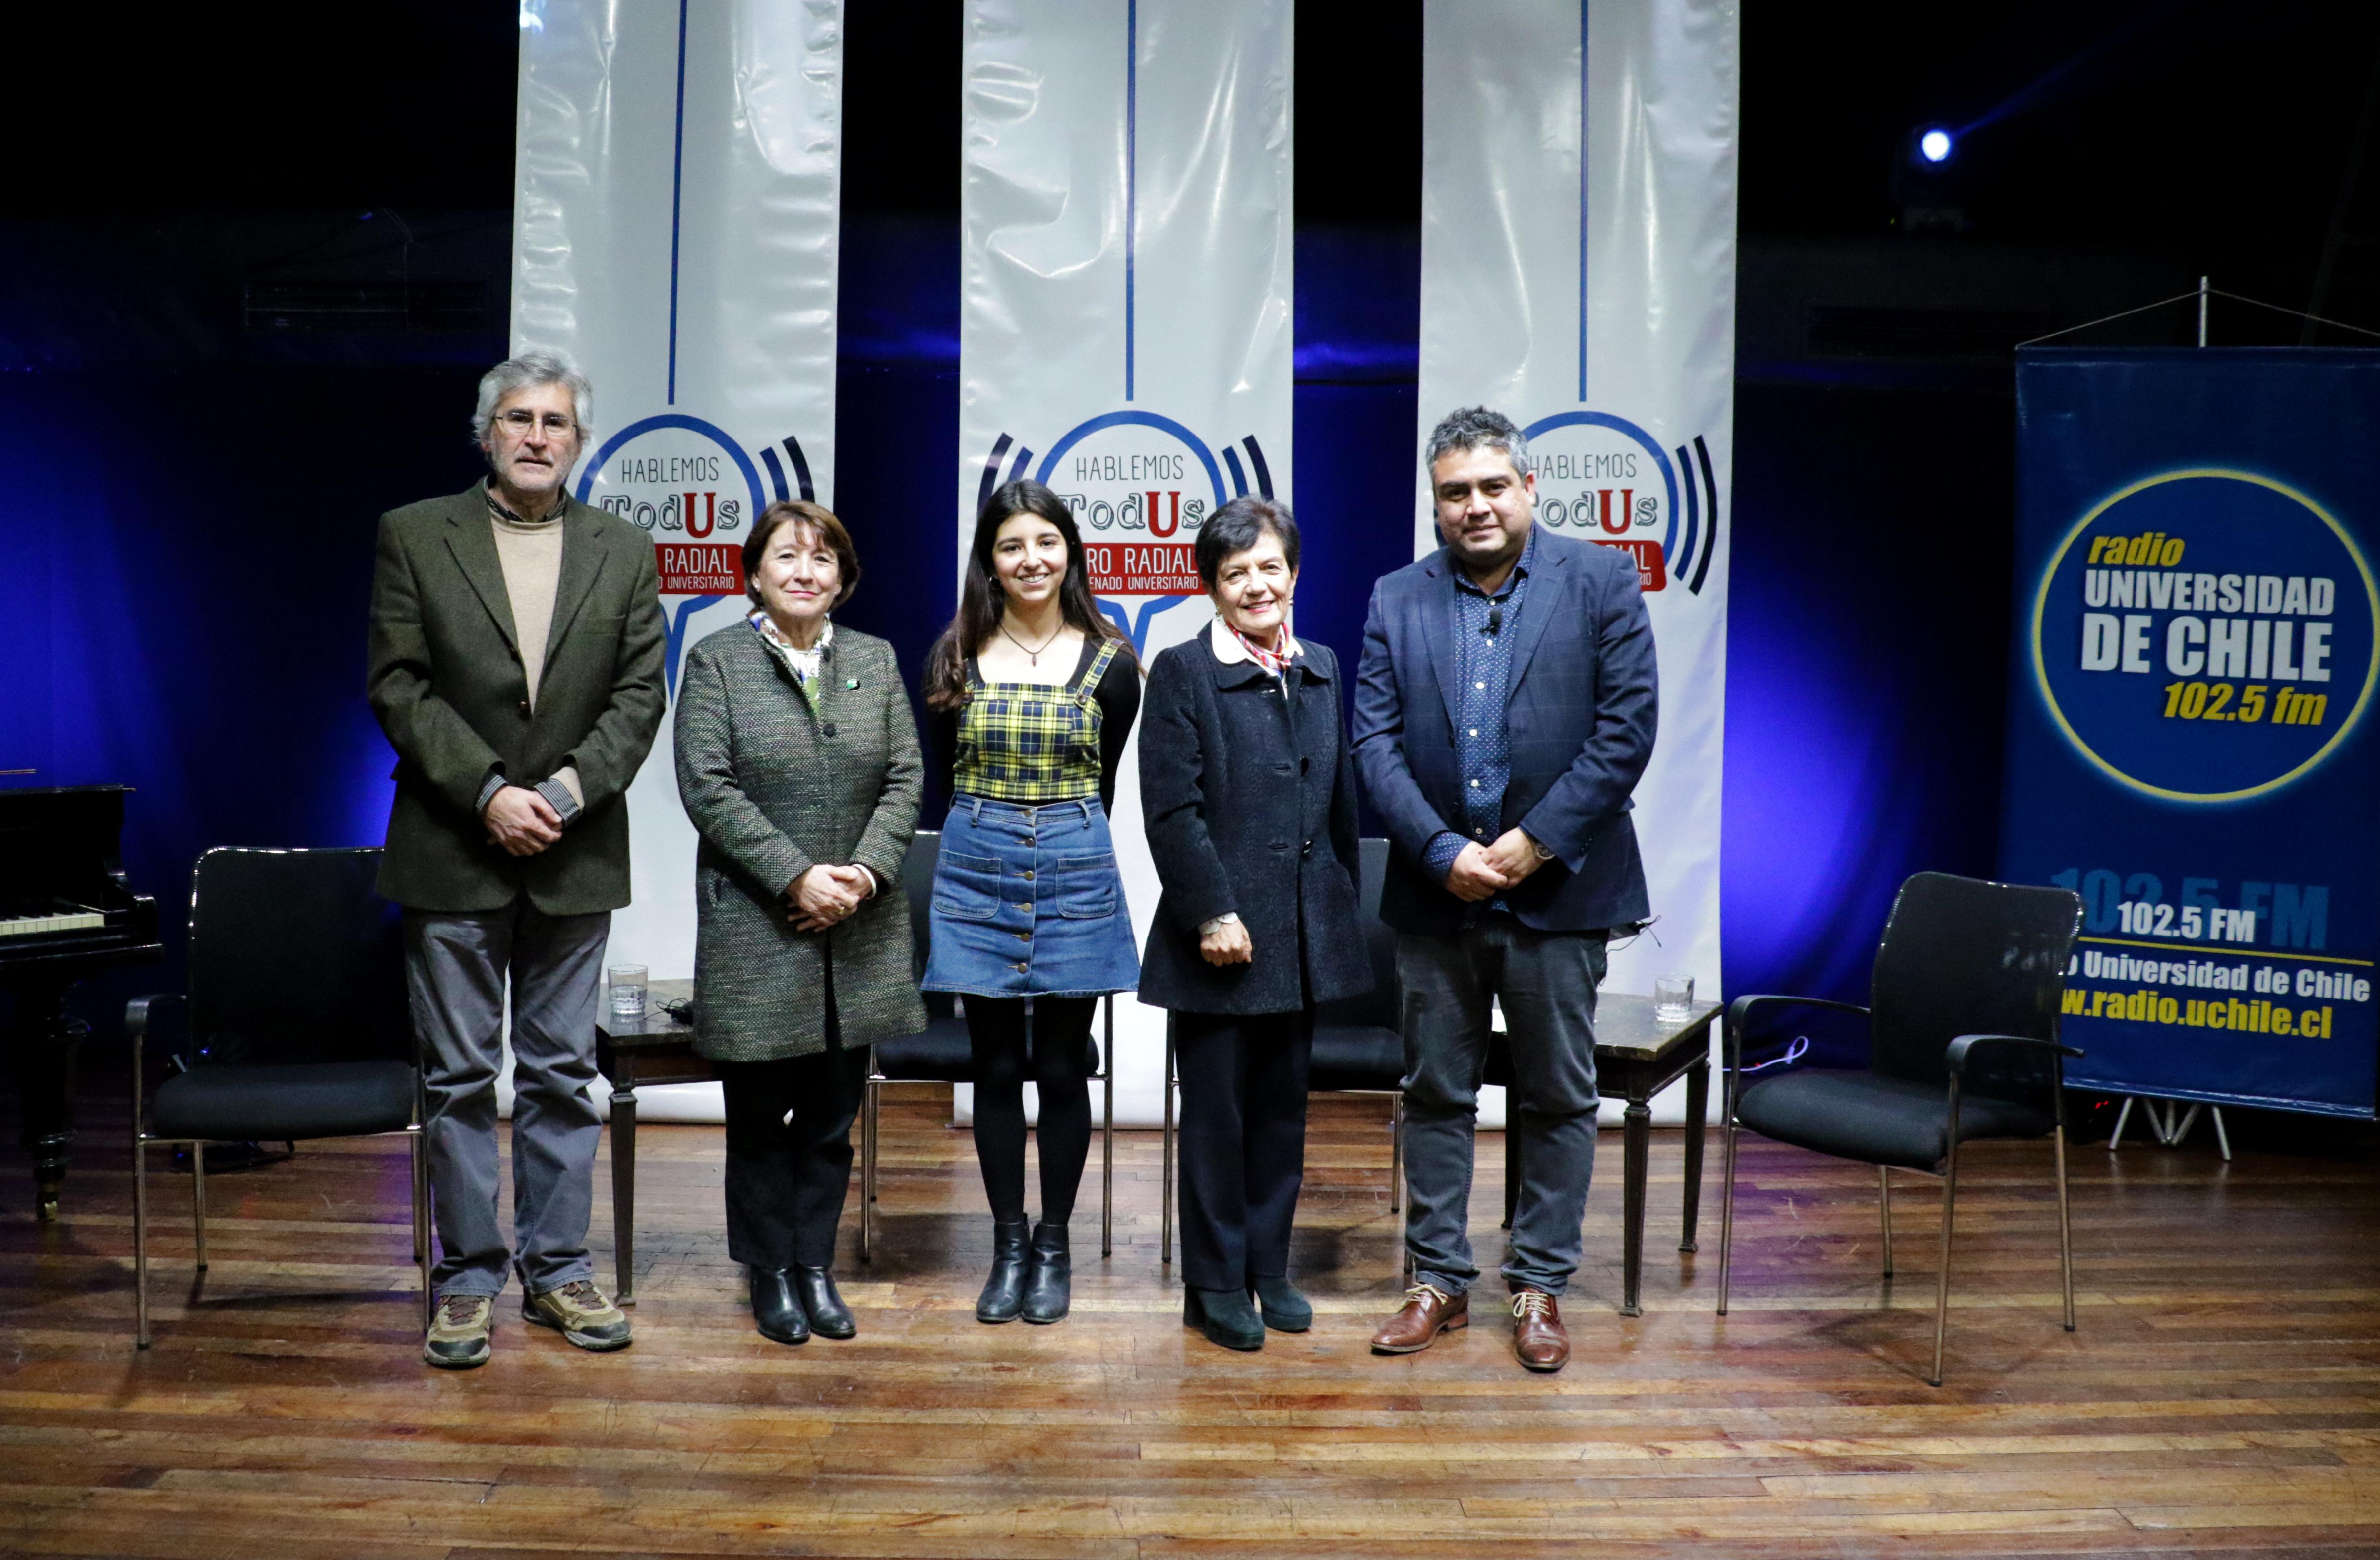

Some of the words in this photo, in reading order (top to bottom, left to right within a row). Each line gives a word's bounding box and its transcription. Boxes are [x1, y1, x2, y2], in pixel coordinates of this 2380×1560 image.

[622, 457, 719, 483] HABLEMOS
[1077, 455, 1183, 481] HABLEMOS
[1530, 454, 1637, 479] HABLEMOS
[1534, 489, 1658, 535] odUs
[664, 548, 733, 574] RADIAL
[1086, 547, 1112, 574] RO
[1124, 547, 1198, 574] RADIAL
[2087, 532, 2185, 567] radio
[667, 576, 735, 589] UNIVERSITARIO
[1089, 576, 1122, 590] ENADO
[1128, 576, 1199, 590] UNIVERSITARIO
[2084, 569, 2335, 616] UNIVERSIDAD
[2081, 613, 2152, 674] DE
[2165, 616, 2333, 682] CHILE
[2163, 681, 2268, 723] 102.5
[2271, 686, 2328, 726] fm
[2116, 900, 2203, 939] 102.5
[2209, 908, 2256, 943] FM
[2240, 881, 2329, 950] FM
[2083, 950, 2250, 992] Universidad
[2253, 966, 2290, 995] de
[2295, 968, 2371, 1002] Chile
[2060, 988, 2333, 1039] w.radio.uchile.cl
